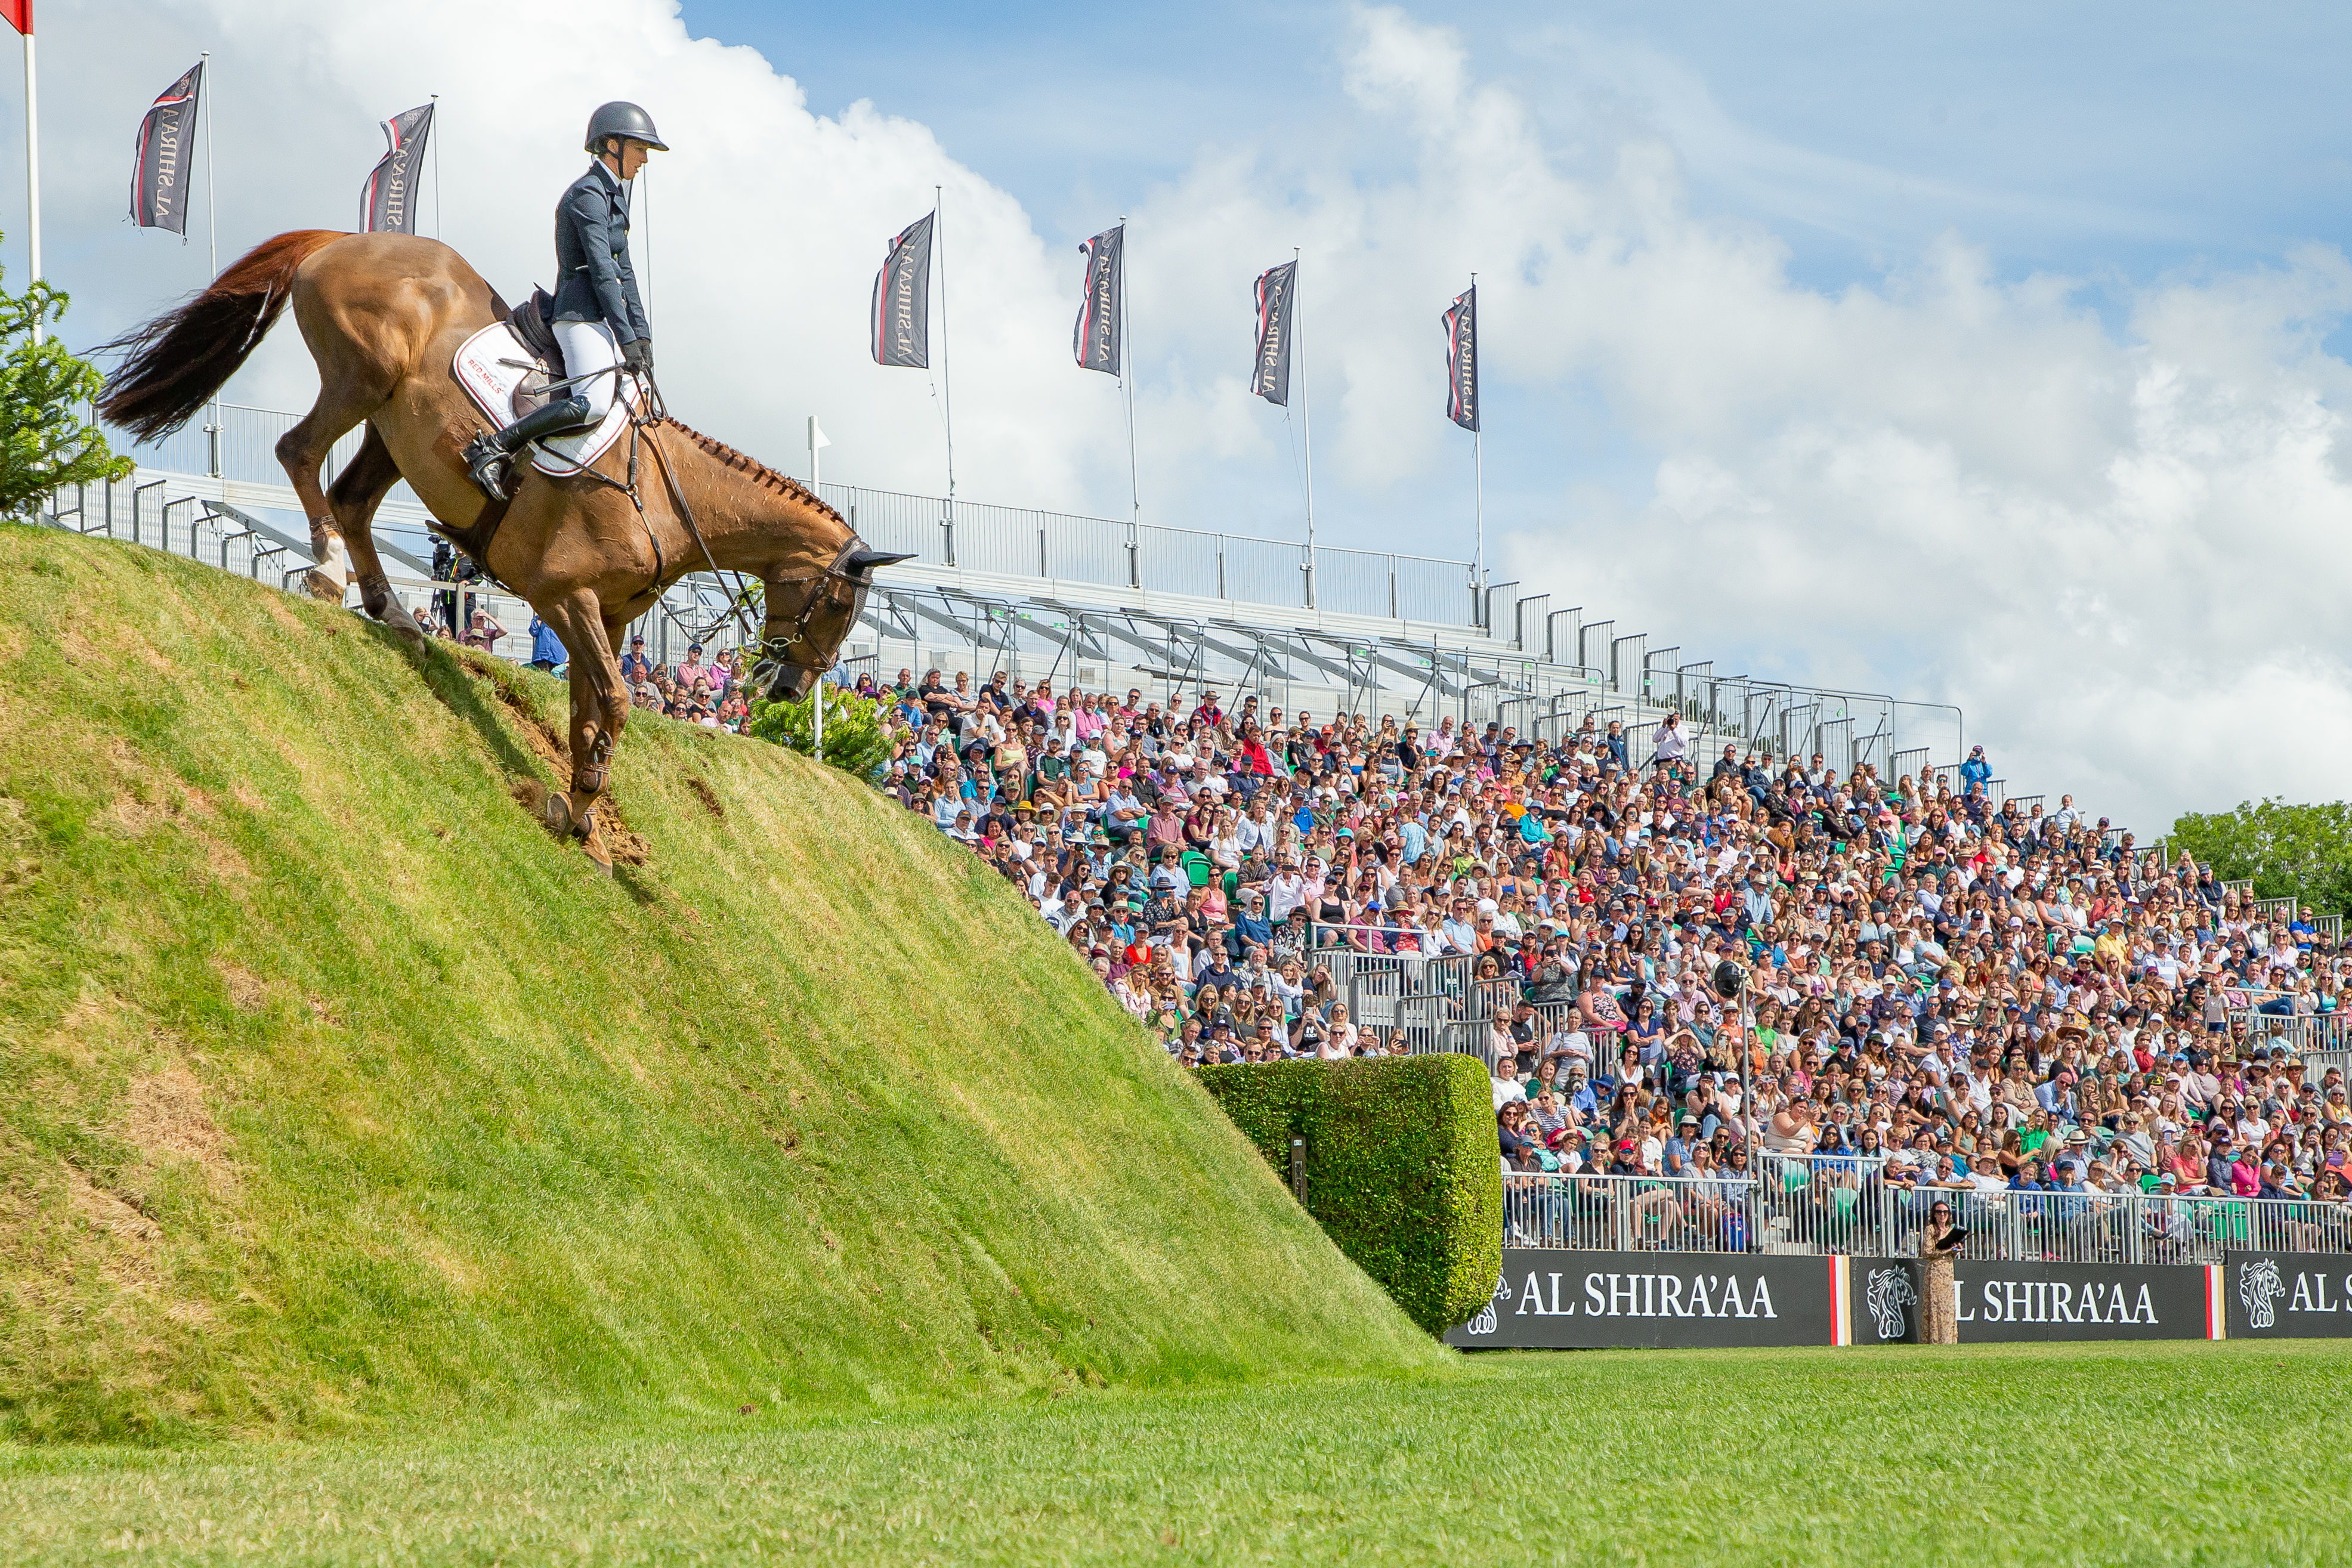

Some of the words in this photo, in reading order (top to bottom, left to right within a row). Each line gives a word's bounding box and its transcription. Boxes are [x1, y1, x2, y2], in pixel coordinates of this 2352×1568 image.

[468, 359, 483, 373] RED
[481, 372, 502, 394] MILLS
[1516, 1270, 1575, 1316] AL
[1954, 1280, 1976, 1321] L
[2289, 1271, 2338, 1312] AL
